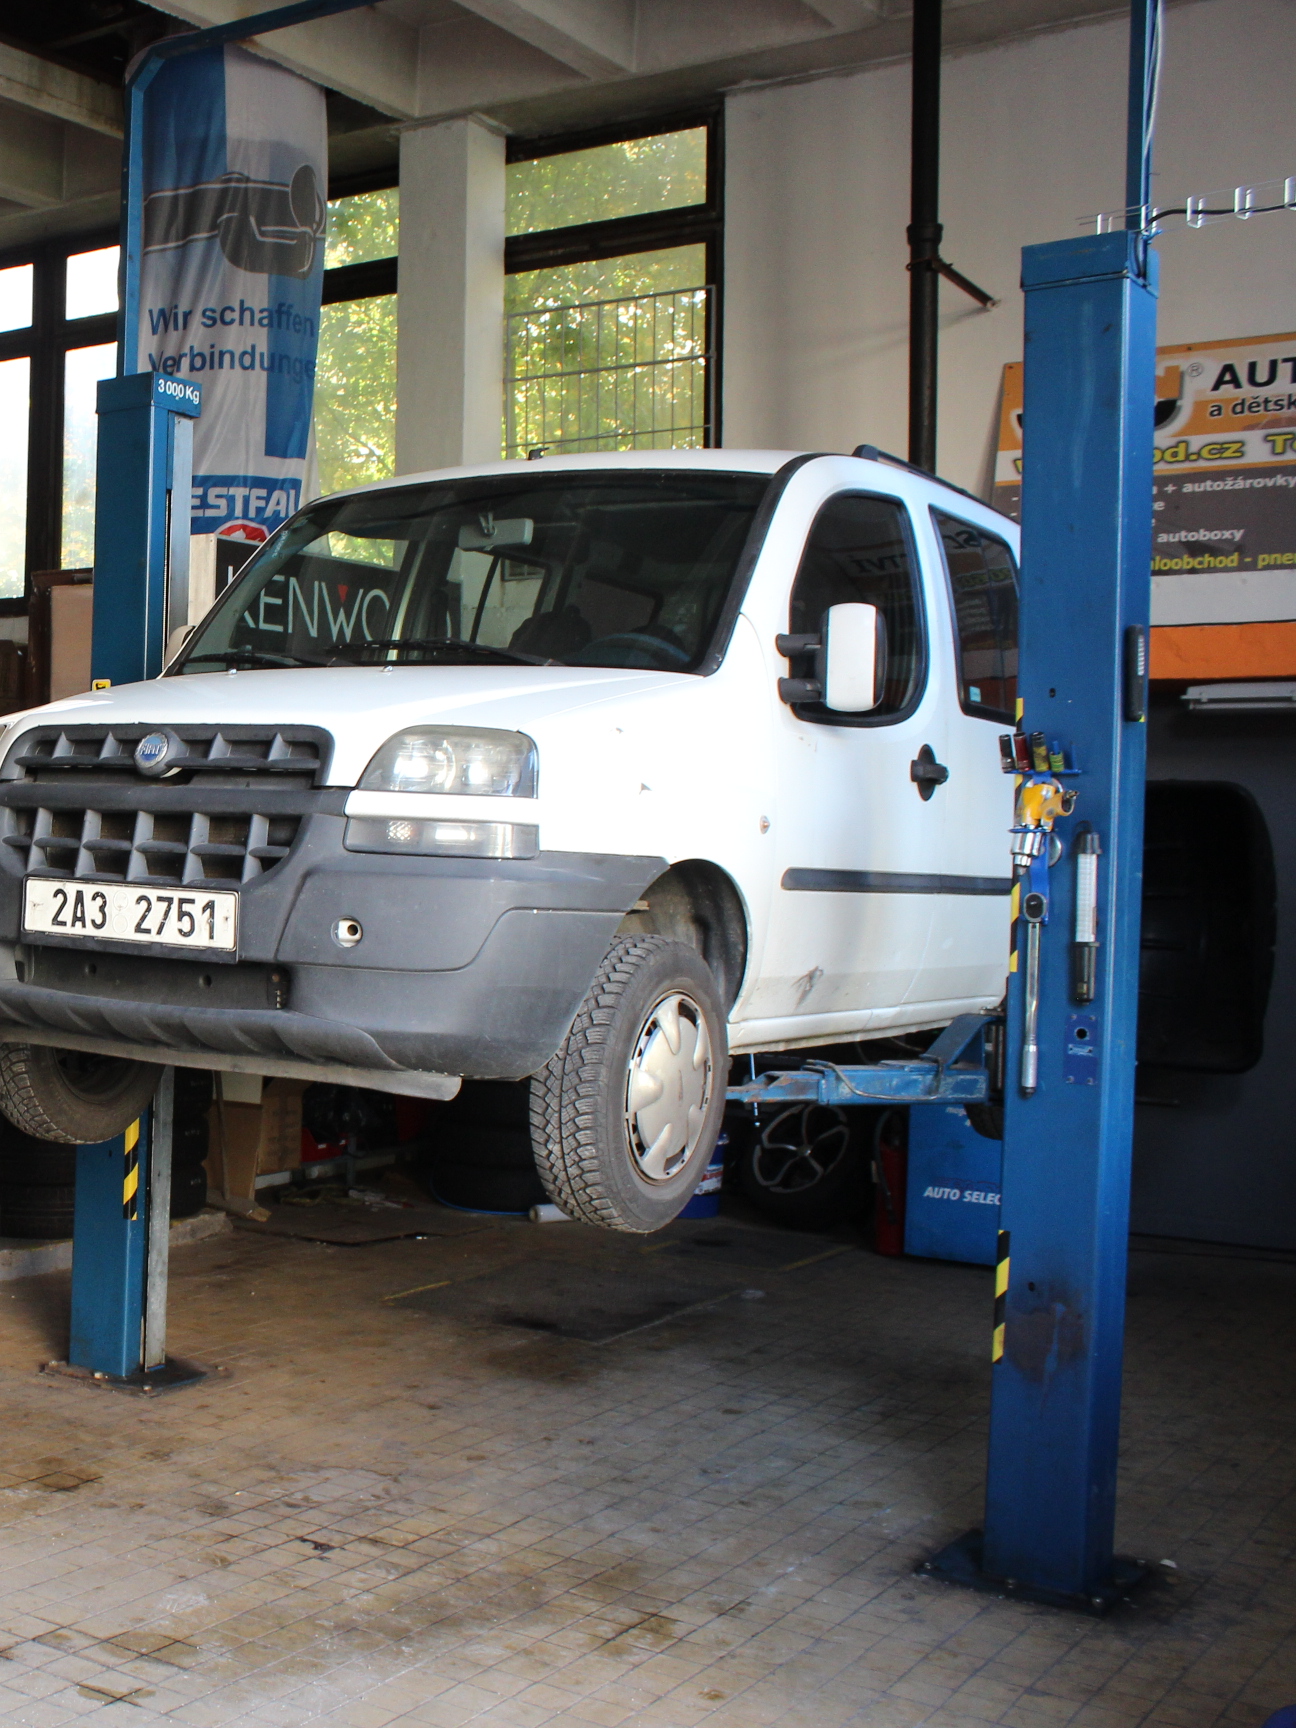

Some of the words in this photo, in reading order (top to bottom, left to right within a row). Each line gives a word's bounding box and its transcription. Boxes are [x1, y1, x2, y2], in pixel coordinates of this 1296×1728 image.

[148, 304, 193, 336] Wir
[201, 299, 315, 337] schaffen
[1209, 403, 1223, 417] a
[1157, 528, 1245, 542] autoboxy
[51, 888, 107, 930] 2A3
[134, 894, 216, 940] 2751
[923, 1186, 961, 1200] AUTO
